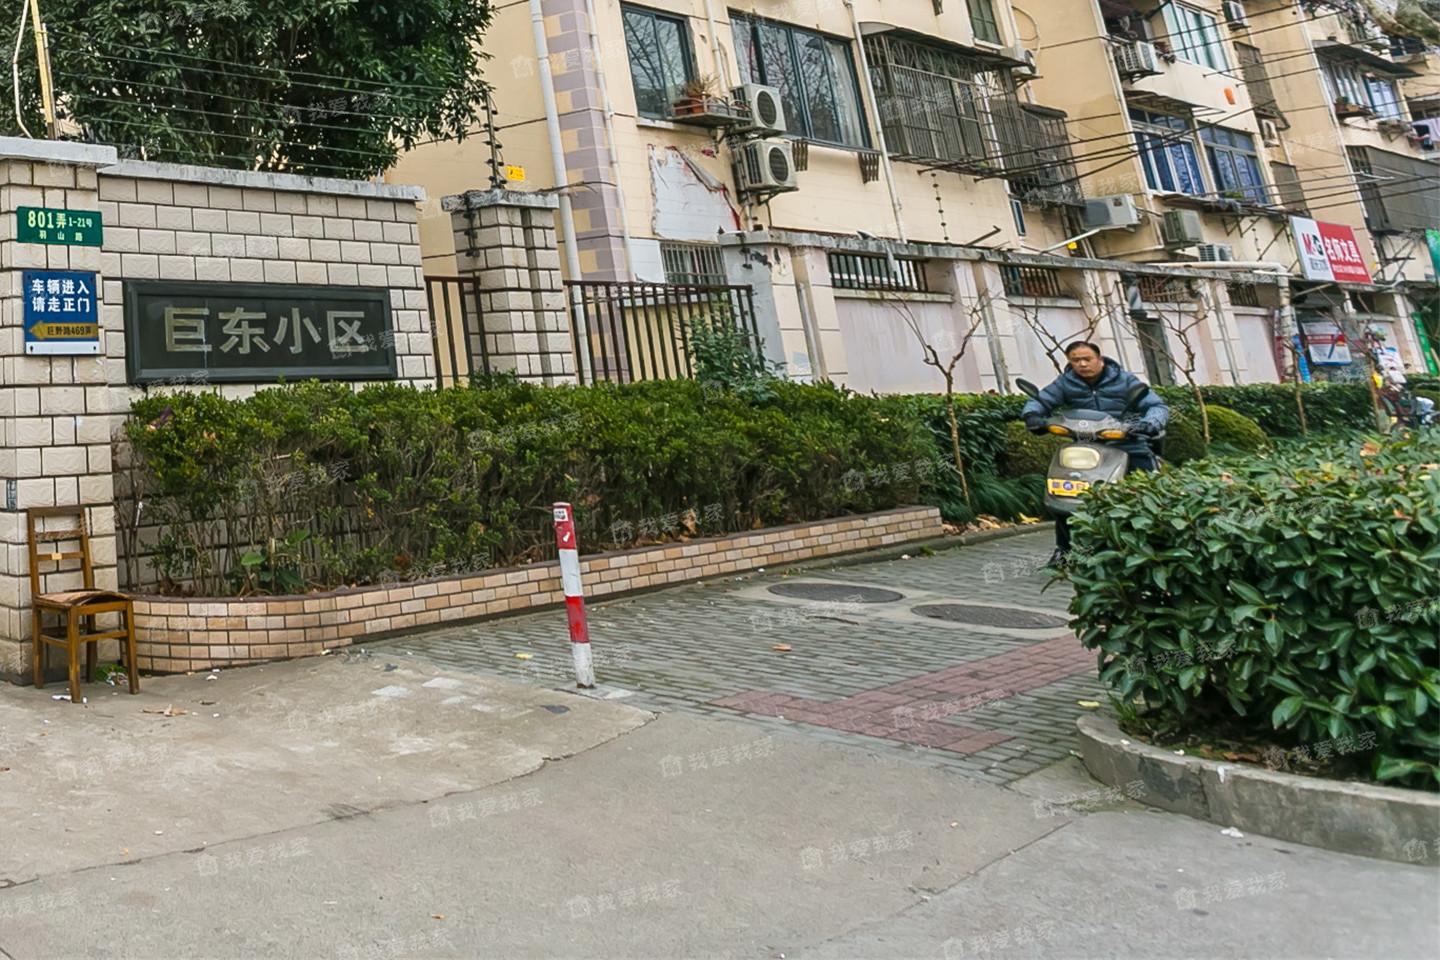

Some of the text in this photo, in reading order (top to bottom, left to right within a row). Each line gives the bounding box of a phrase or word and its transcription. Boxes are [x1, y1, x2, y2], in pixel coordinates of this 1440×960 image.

[27, 210, 67, 229] 801弄
[31, 278, 90, 295] 车辆进入
[32, 296, 90, 313] 请走正门
[164, 306, 370, 355] 巨东小区
